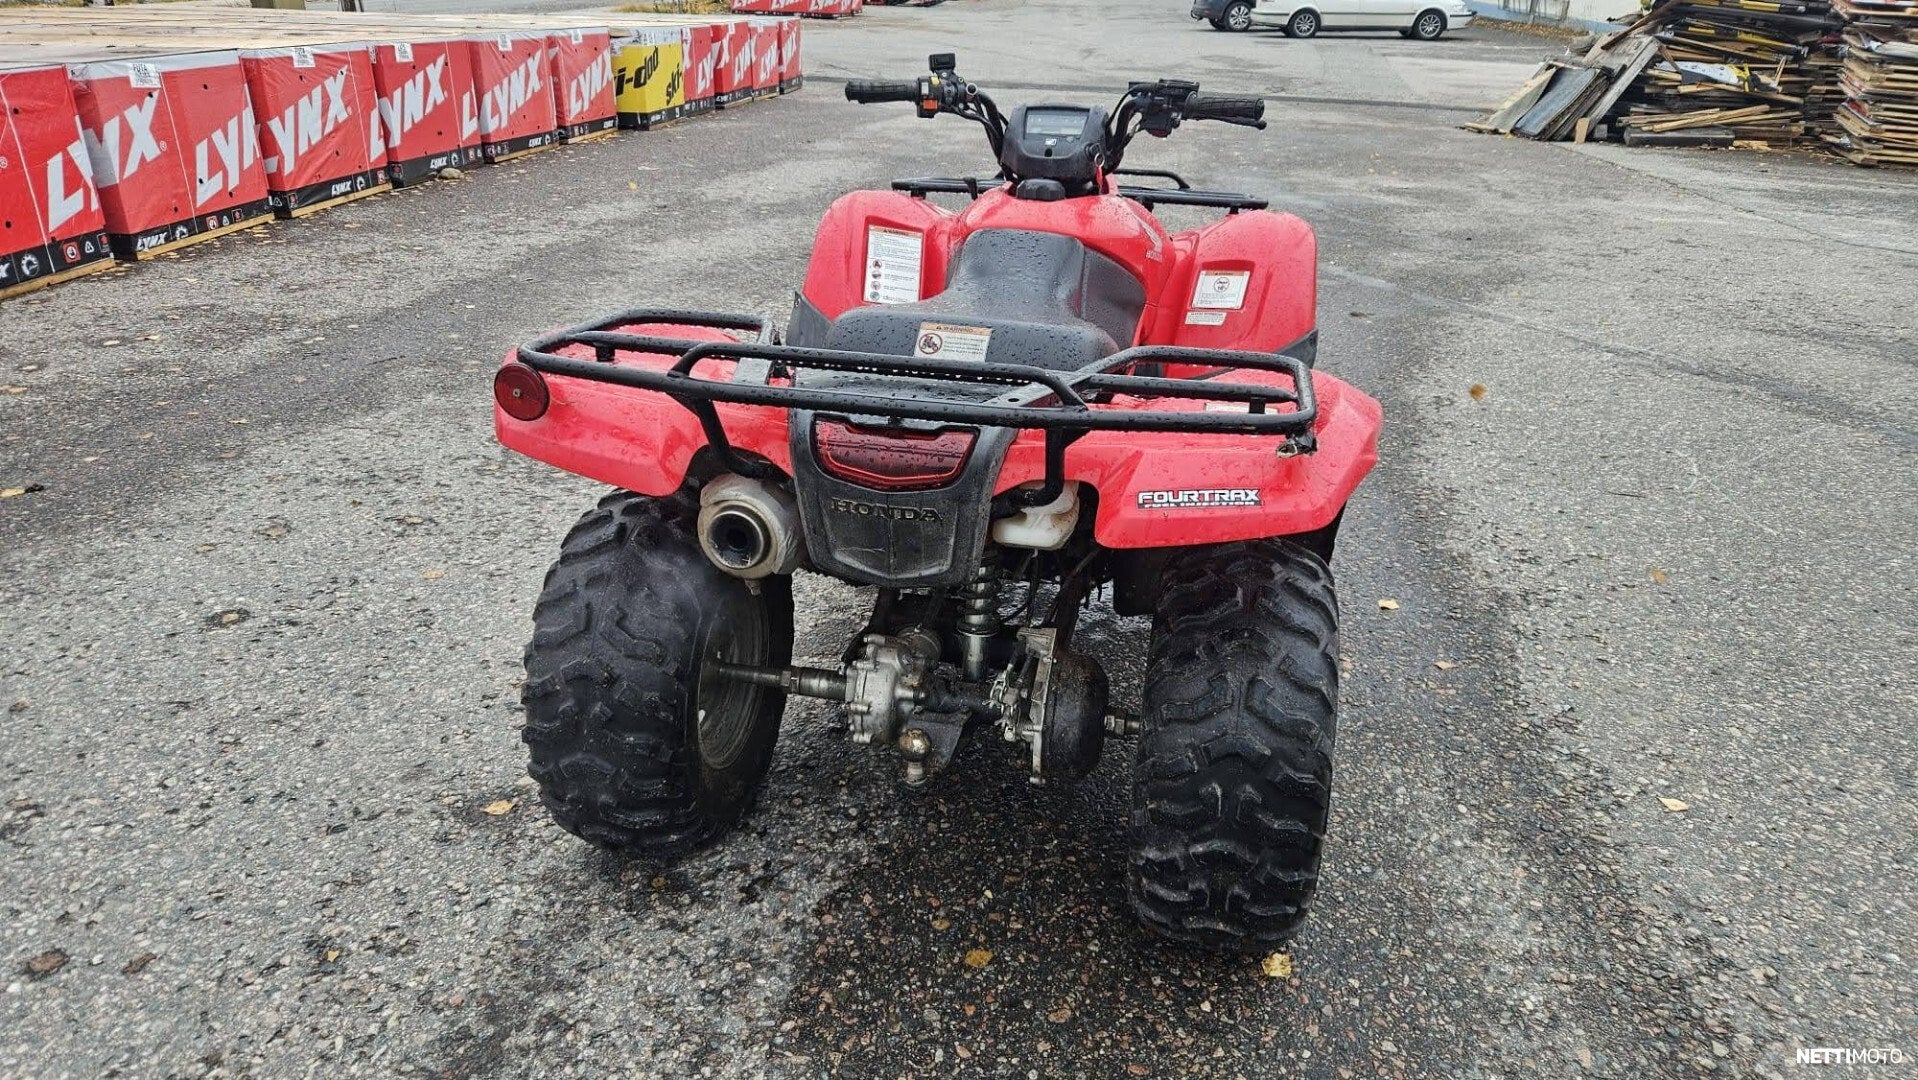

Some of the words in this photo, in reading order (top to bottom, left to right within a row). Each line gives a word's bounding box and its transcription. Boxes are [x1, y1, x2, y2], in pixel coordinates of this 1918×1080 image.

[569, 47, 614, 120] LYNX
[612, 46, 659, 97] i-doo
[480, 49, 542, 135] LYNX
[137, 232, 167, 251] LYNX
[830, 497, 943, 521] HONDA
[1138, 489, 1260, 504] FOURTRAX
